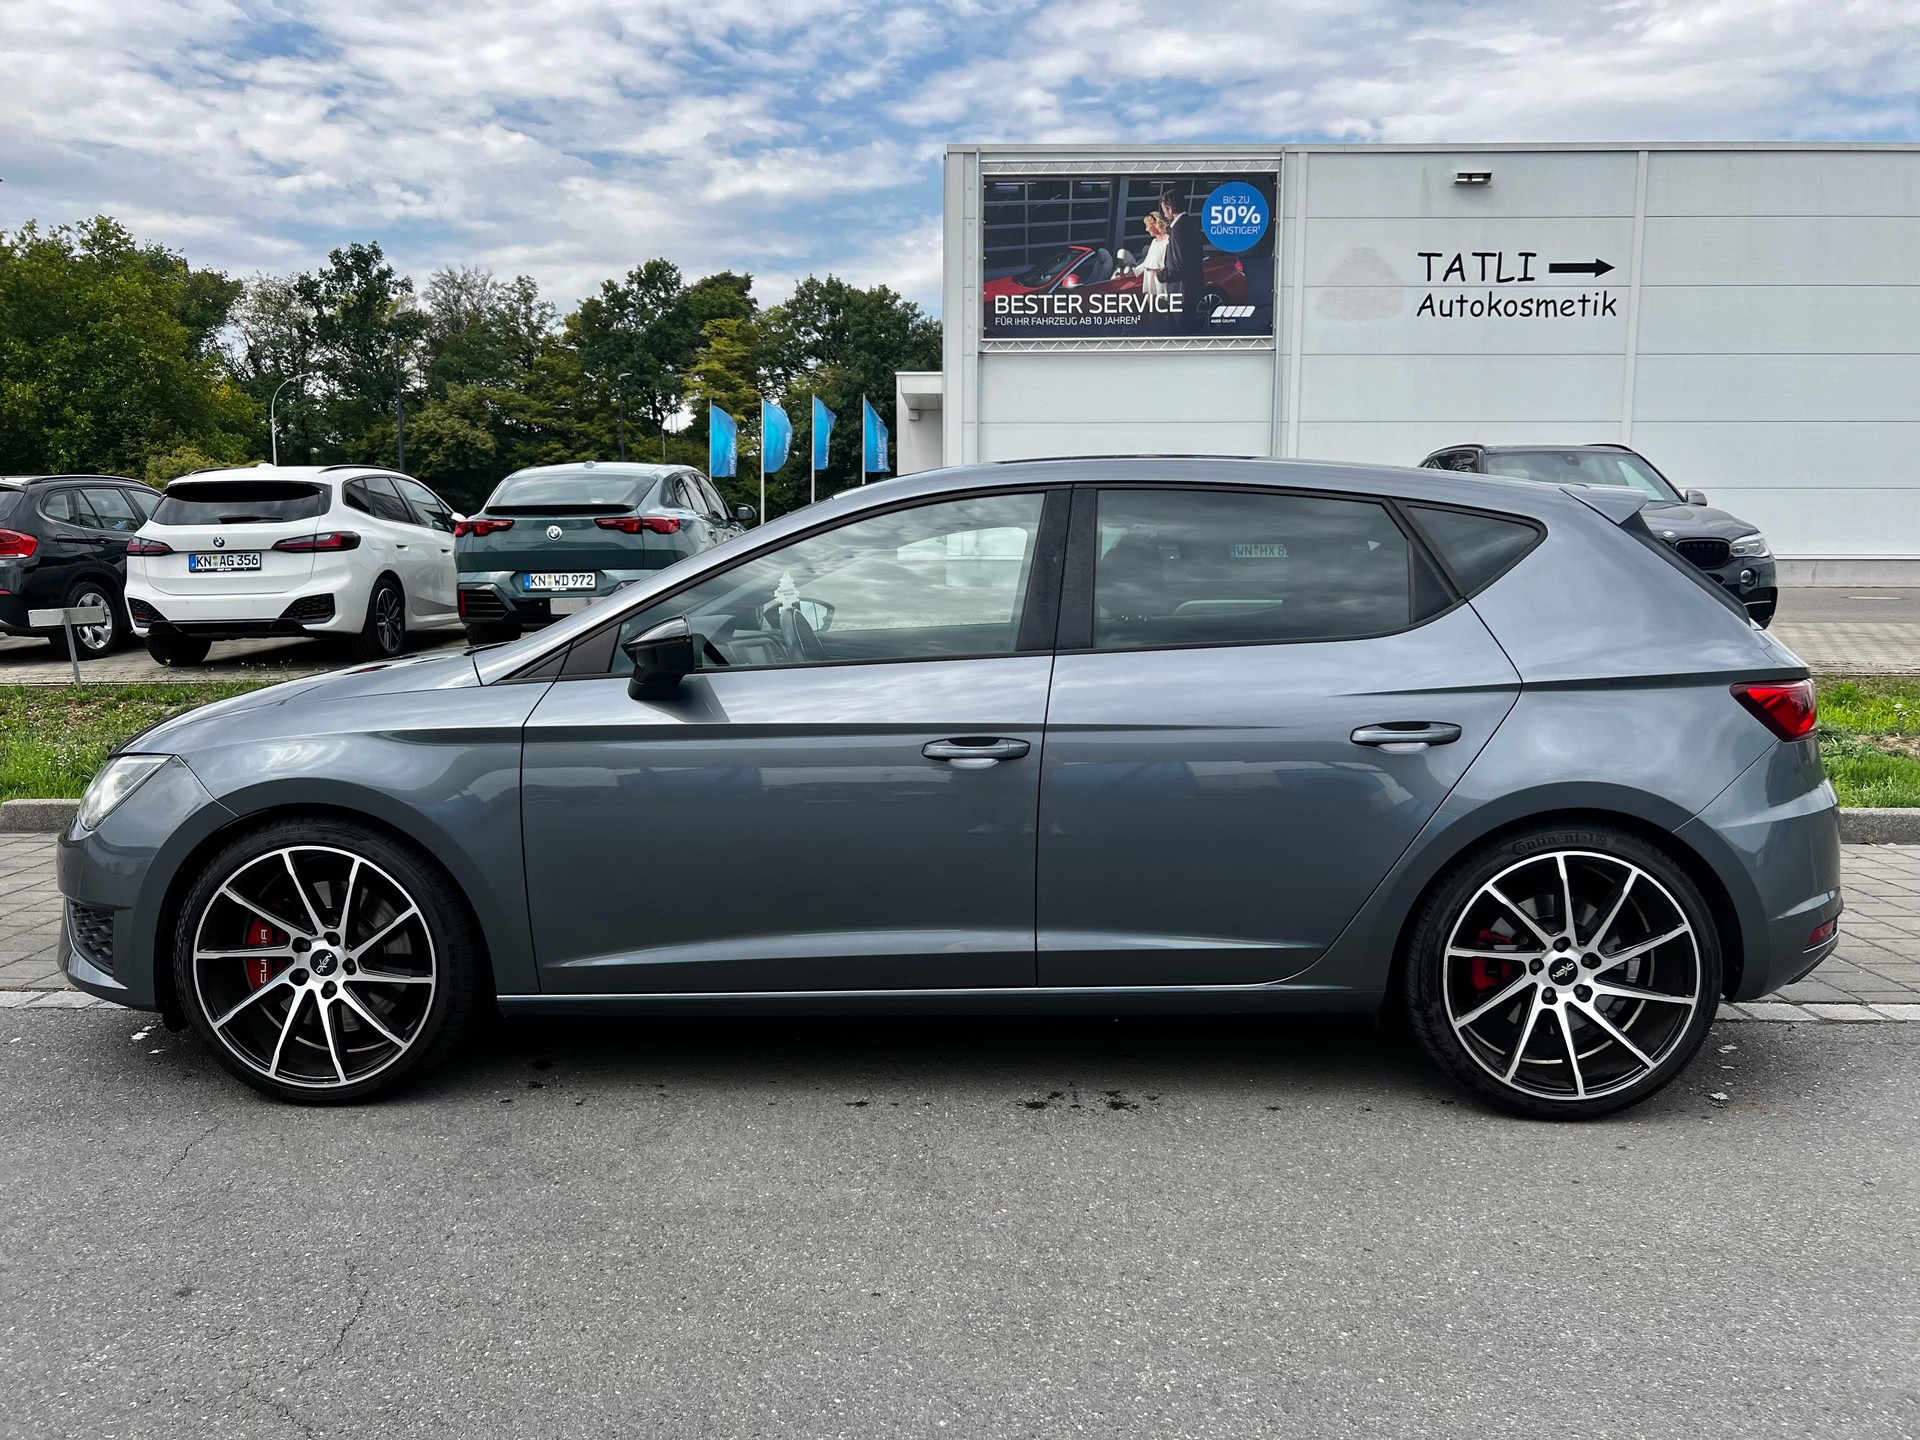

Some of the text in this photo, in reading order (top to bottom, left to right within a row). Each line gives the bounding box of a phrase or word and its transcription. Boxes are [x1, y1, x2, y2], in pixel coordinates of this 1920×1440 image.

[1222, 195, 1250, 205] BIS ZU
[1210, 205, 1261, 225] 50%
[1417, 251, 1537, 283] TATLI
[994, 293, 1184, 315] BESTER SERVICE
[1416, 290, 1617, 318] Autokosmetik
[994, 316, 1013, 326] FÜR
[1014, 316, 1030, 326] IHR
[1031, 316, 1078, 326] FAHRZEUG
[1078, 316, 1092, 325] AB
[1093, 316, 1102, 325] 10
[1236, 545, 1253, 557] WN
[196, 554, 259, 567] KN AG 356
[530, 574, 593, 586] KN WD 972
